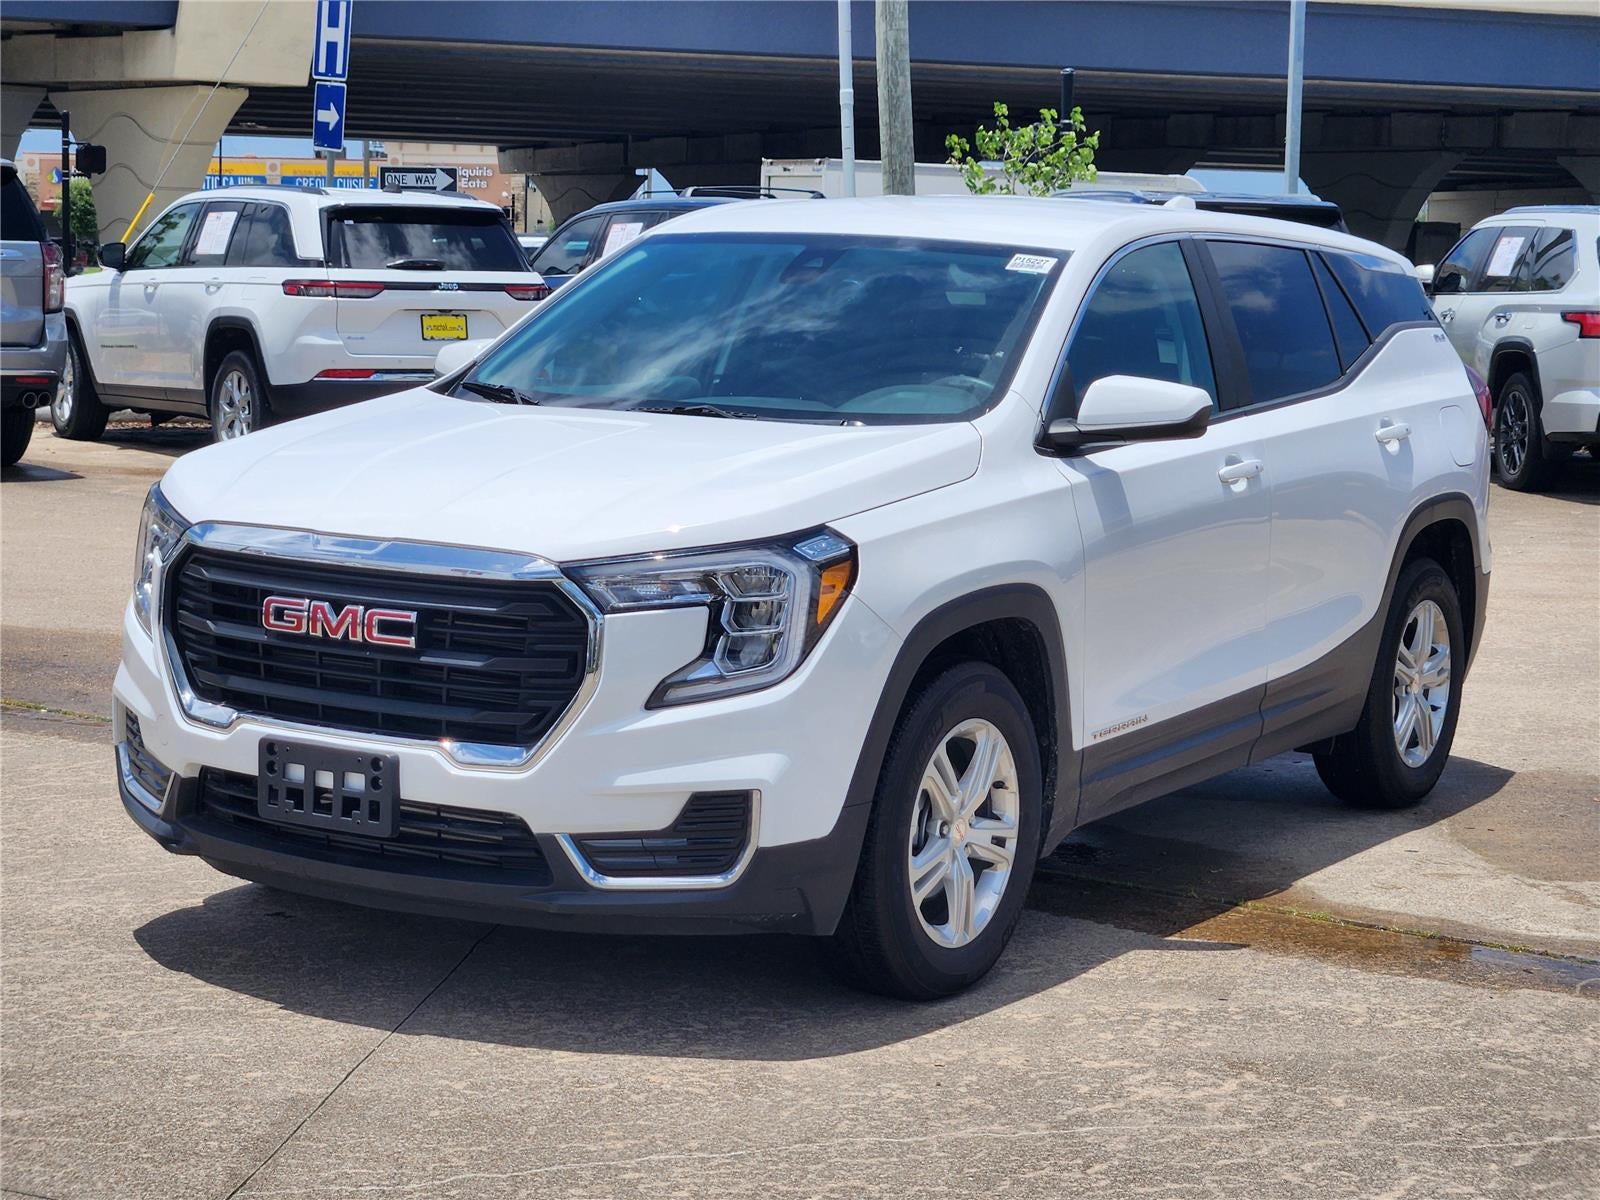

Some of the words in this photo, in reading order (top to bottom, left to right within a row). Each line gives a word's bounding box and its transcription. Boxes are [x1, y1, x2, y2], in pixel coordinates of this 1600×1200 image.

[318, 0, 347, 75] H
[458, 166, 493, 177] iquiris
[386, 174, 408, 185] ONE
[415, 174, 437, 185] WAY
[461, 178, 488, 188] Eats
[438, 282, 459, 290] Jeep
[262, 595, 418, 649] GMC
[1091, 713, 1148, 740] TERRAIN
